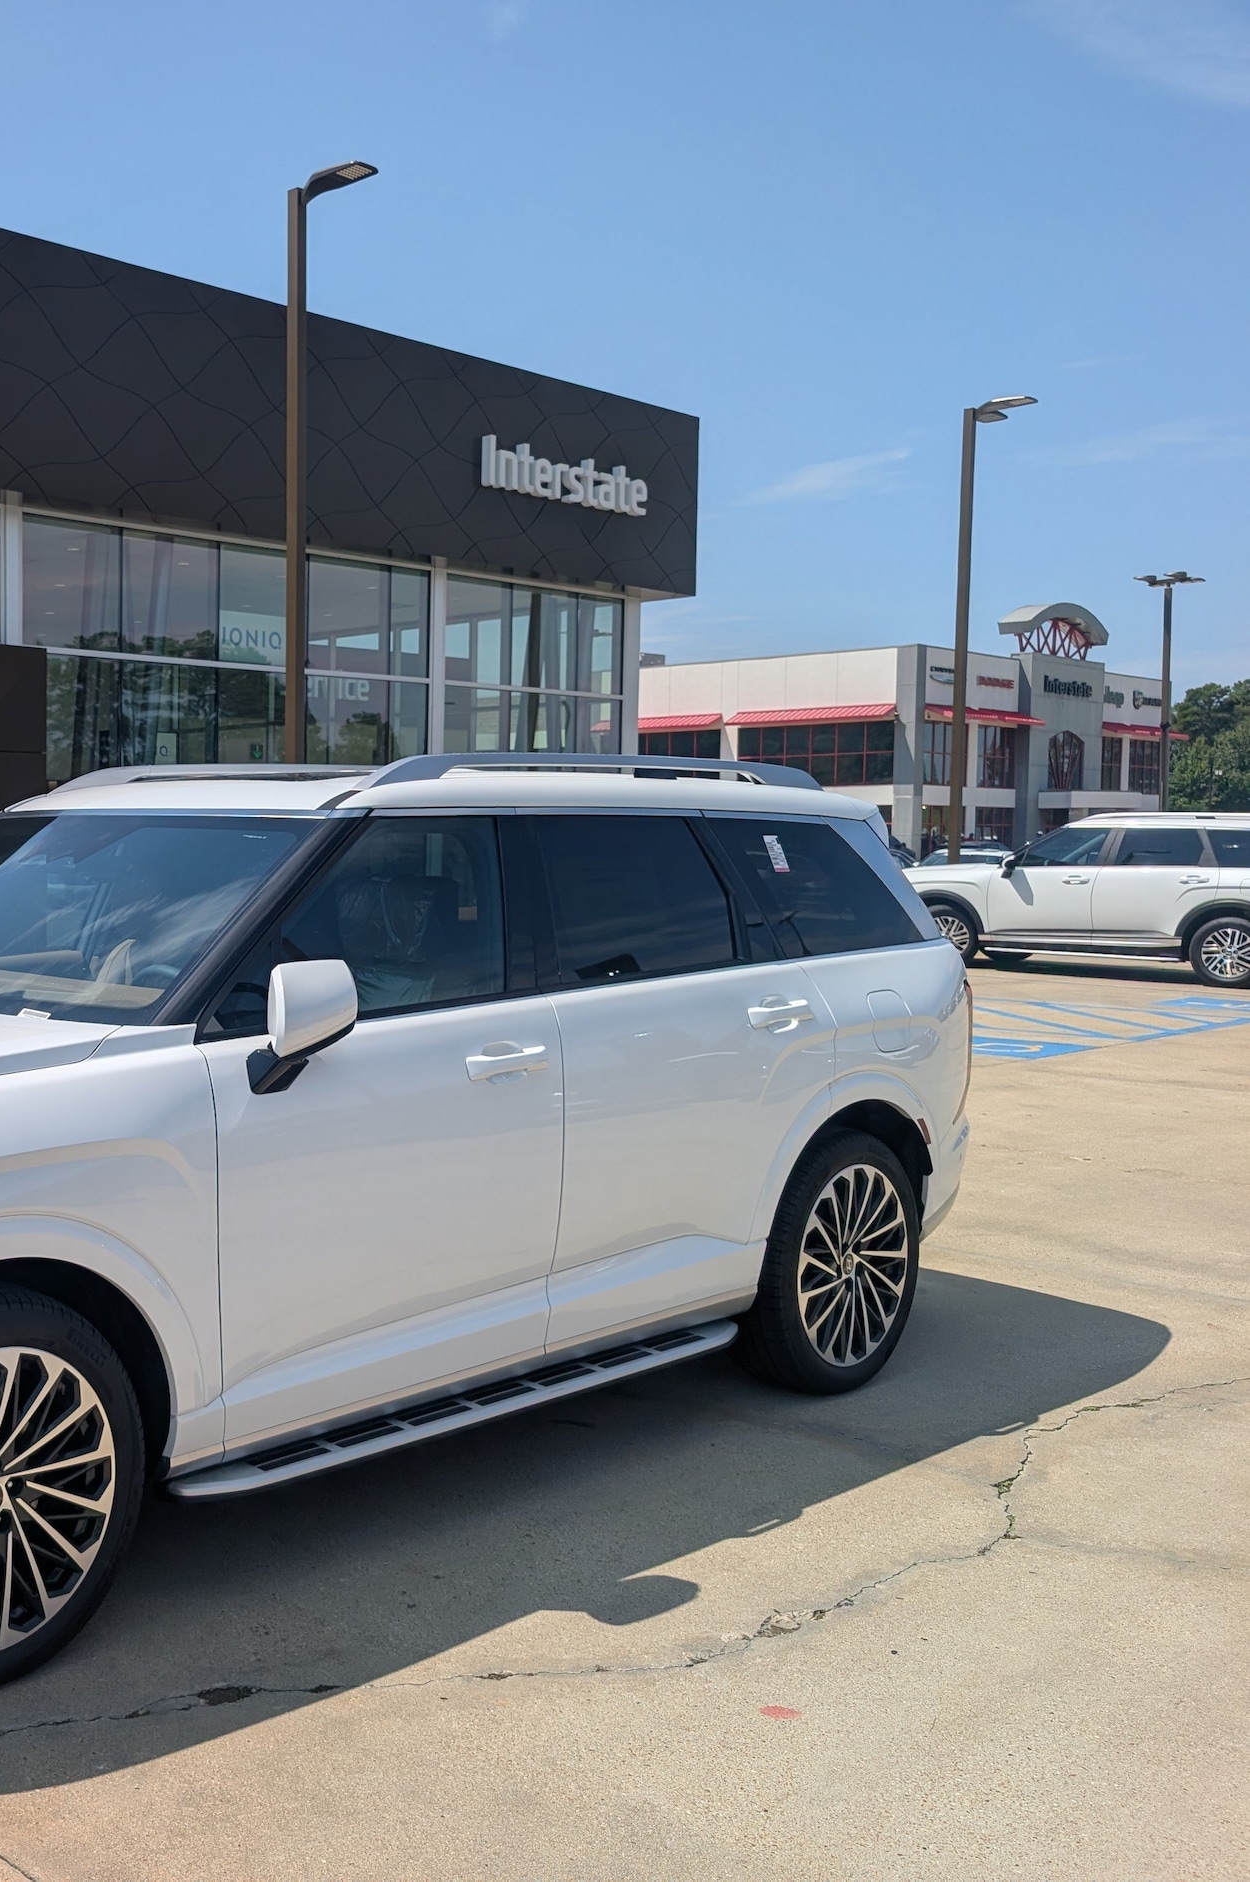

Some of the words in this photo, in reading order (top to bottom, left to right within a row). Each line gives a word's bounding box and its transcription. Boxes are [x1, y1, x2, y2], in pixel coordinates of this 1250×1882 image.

[481, 434, 648, 517] Interstate
[222, 626, 282, 650] IONIQ
[1043, 674, 1093, 698] Interstate
